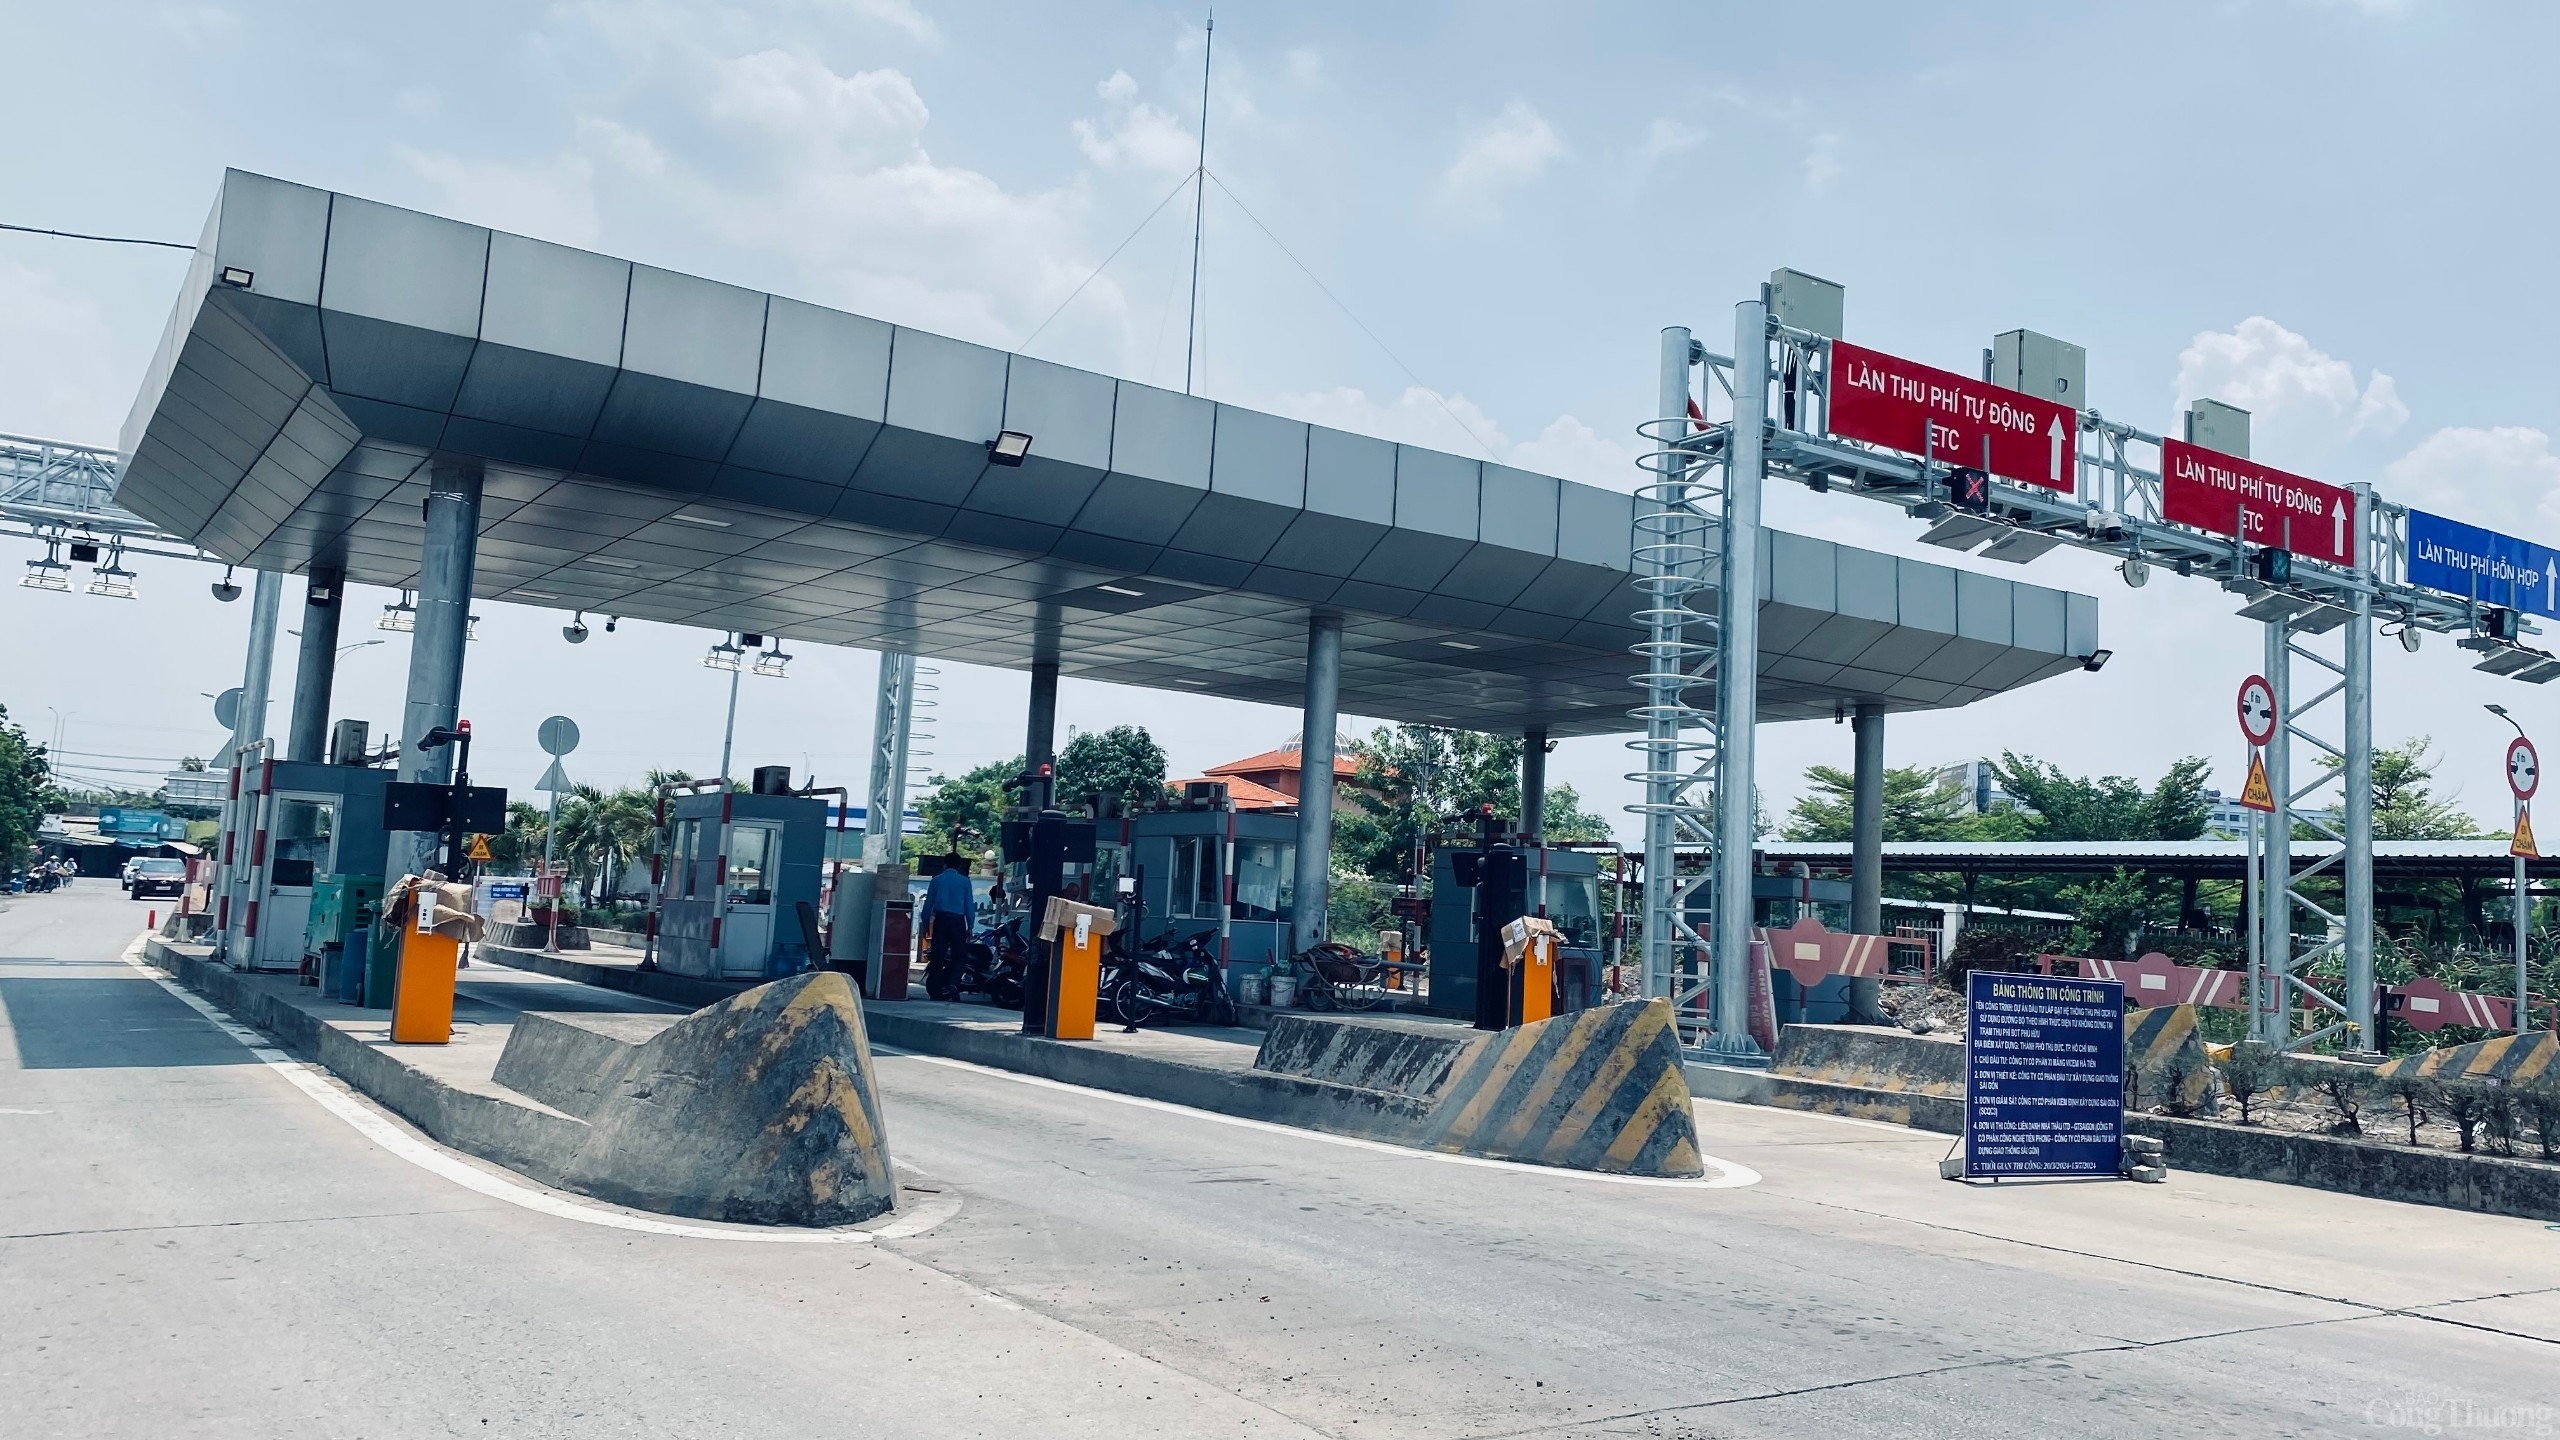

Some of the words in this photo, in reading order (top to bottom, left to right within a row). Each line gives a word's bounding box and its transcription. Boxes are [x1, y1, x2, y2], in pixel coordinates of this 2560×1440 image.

[1848, 361, 1885, 394] LÀN
[1890, 373, 1925, 403] THU
[1931, 386, 1959, 414] PHÍ
[1963, 394, 1984, 423] TỰ
[1989, 402, 2035, 434] ĐỘNG
[2176, 455, 2205, 480] LÀN
[2209, 466, 2235, 490] THU
[2240, 475, 2262, 499] PHÍ
[2265, 482, 2283, 507] TỰ
[2286, 487, 2322, 516] ĐỘNG
[2418, 538, 2442, 564] LÀN
[2445, 548, 2468, 569] THU
[2471, 555, 2490, 575] PHÍ
[2492, 556, 2514, 579] HỖN
[2518, 568, 2539, 590] HỢP
[2248, 788, 2267, 803] CHẬM
[2254, 773, 2261, 784] ĐI
[1993, 979, 2015, 997] BẢNG
[2018, 983, 2043, 999] THÔNG
[2046, 988, 2057, 1000] TIN
[2060, 985, 2080, 1001] CÔNG
[2083, 987, 2104, 1003] TRÌNH
